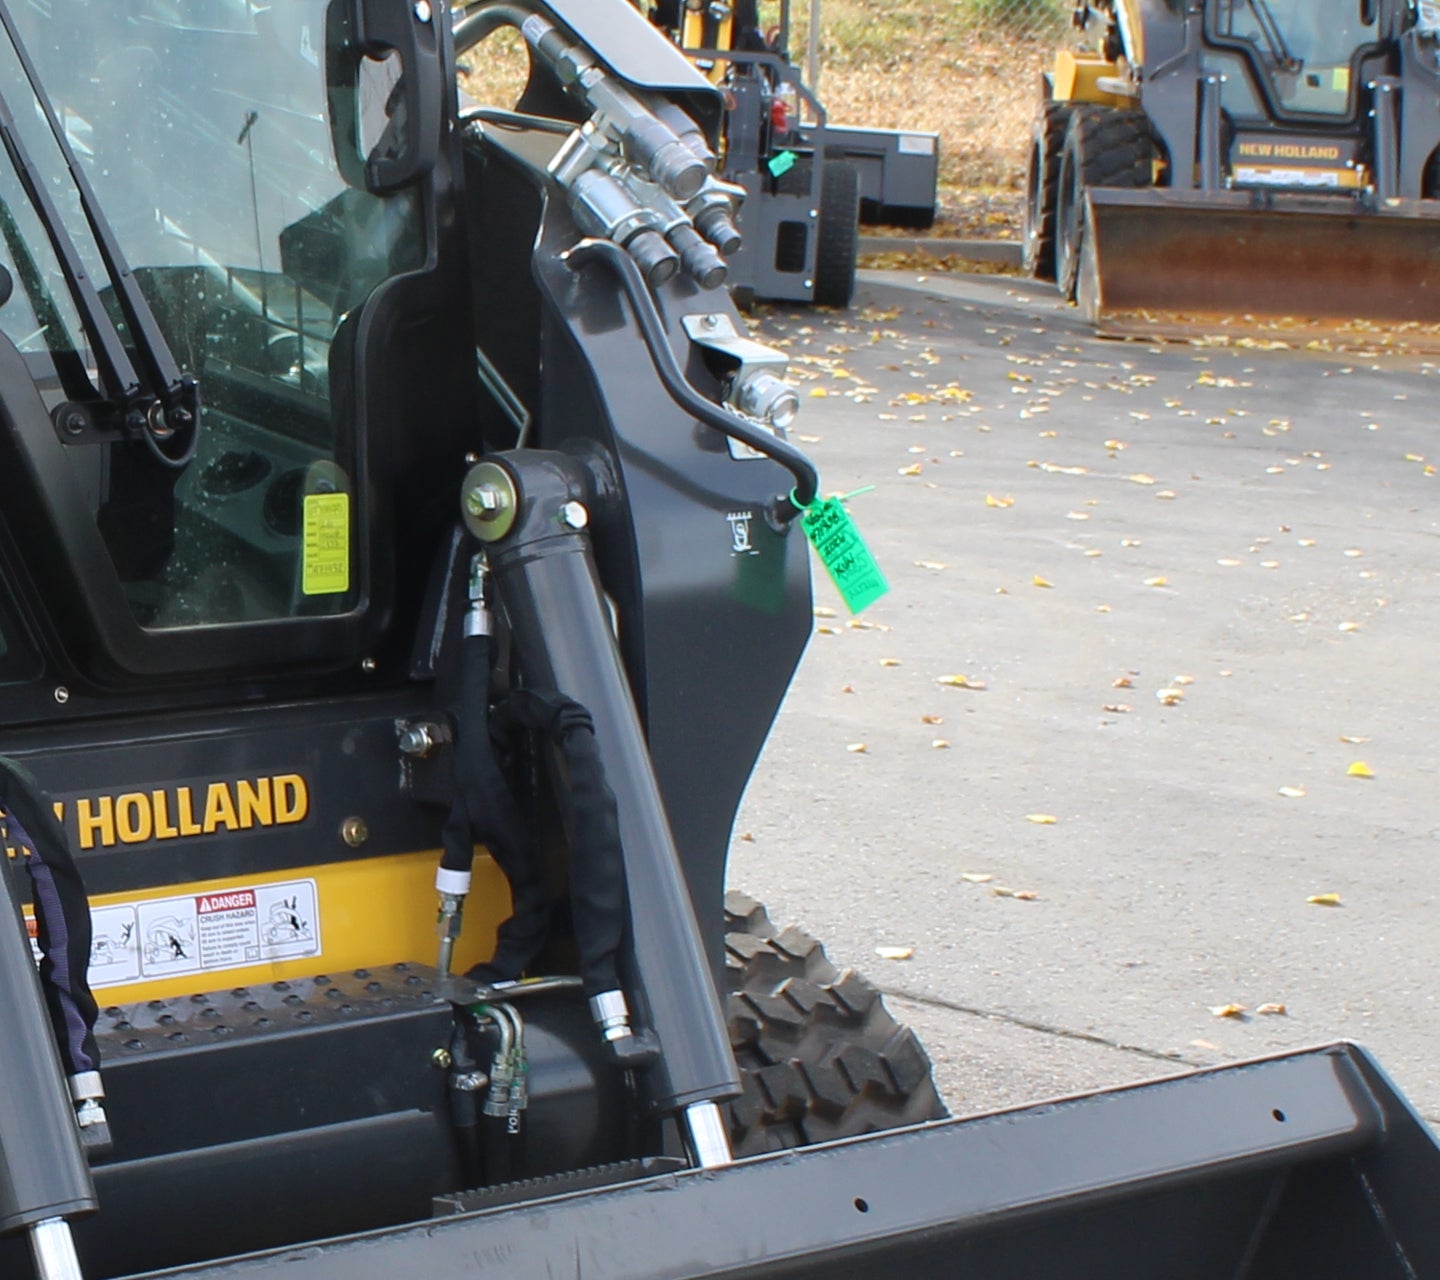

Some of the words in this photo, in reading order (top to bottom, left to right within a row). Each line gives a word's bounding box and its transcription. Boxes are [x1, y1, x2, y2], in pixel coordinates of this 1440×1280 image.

[1239, 143, 1271, 157] NEW
[1273, 145, 1340, 160] HOLLAND
[76, 773, 309, 850] HOLLAND
[211, 893, 253, 909] DANGER
